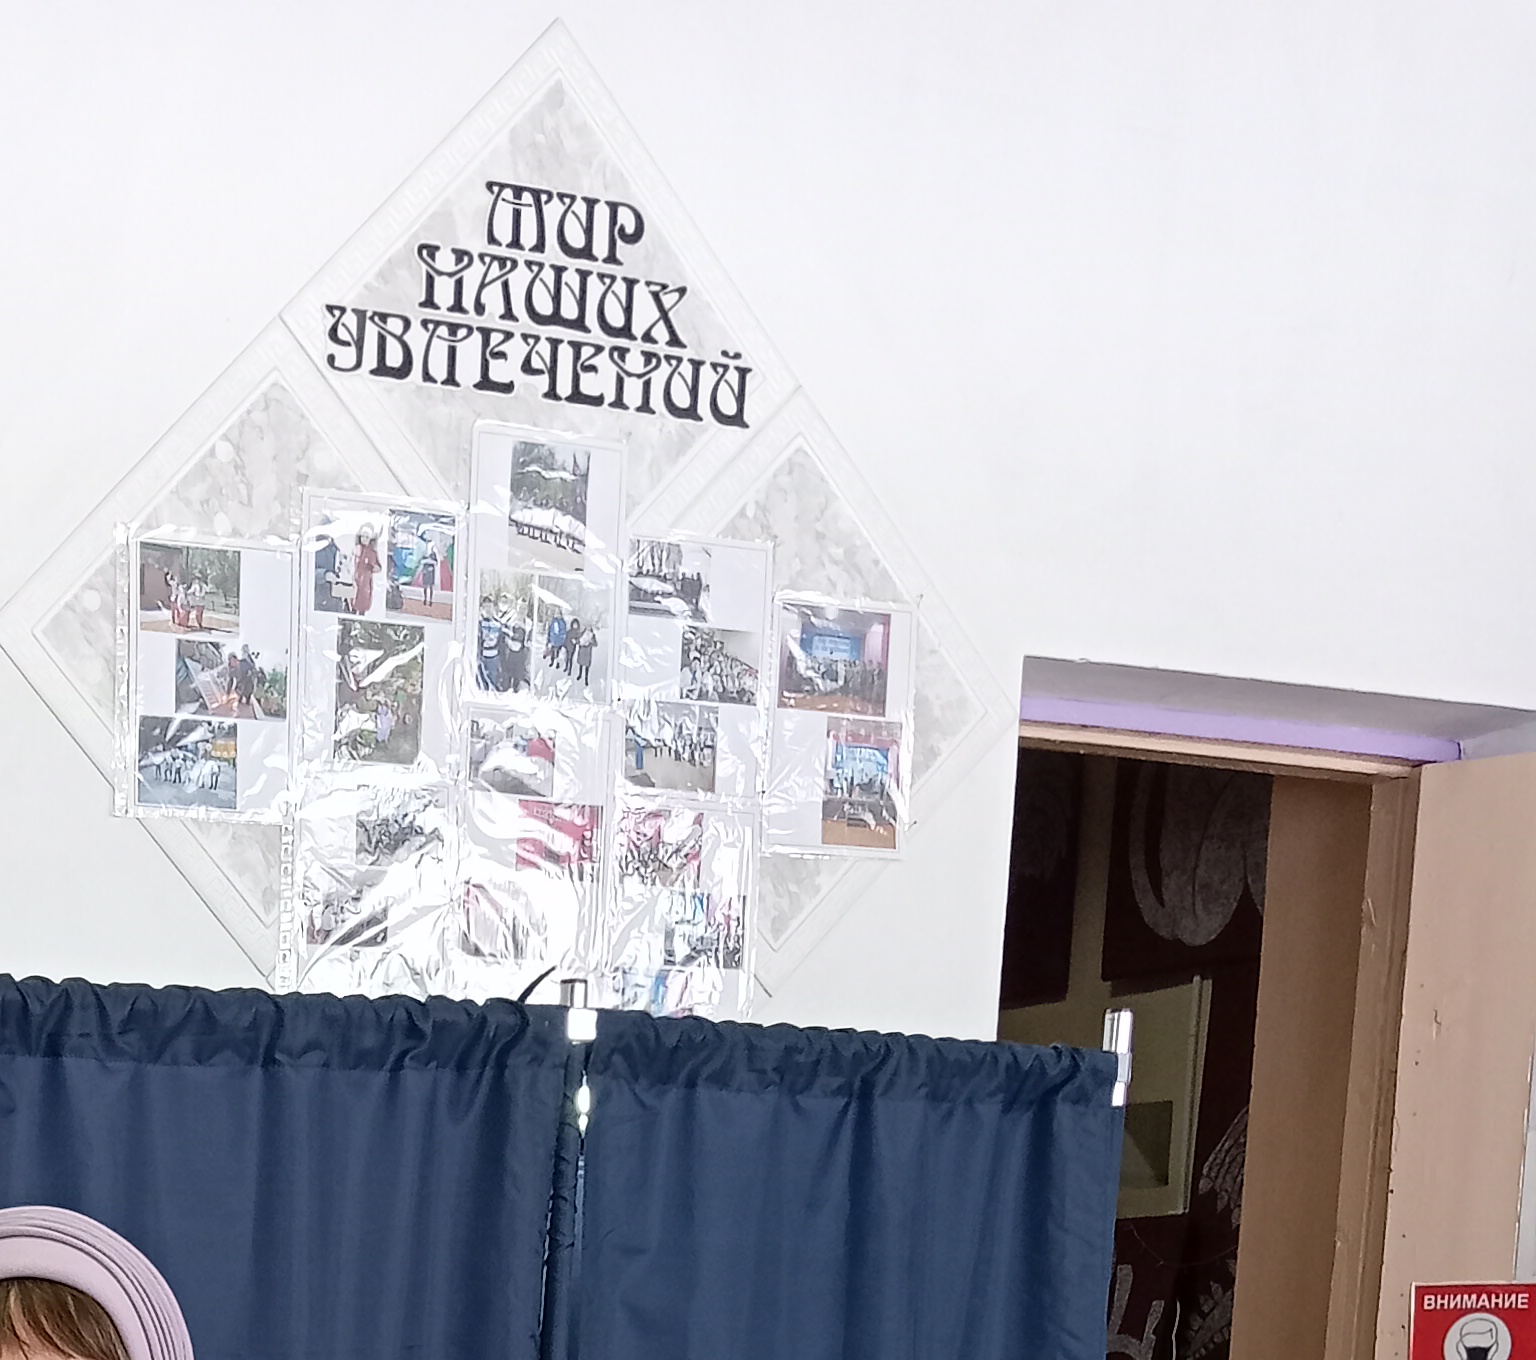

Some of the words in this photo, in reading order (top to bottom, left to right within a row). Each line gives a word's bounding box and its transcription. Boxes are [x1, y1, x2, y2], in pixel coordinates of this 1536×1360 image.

[485, 180, 645, 266] МИР
[416, 243, 688, 349] НАШИХ
[325, 303, 753, 429] УВЛЕЧЕНИЙ
[1423, 1293, 1529, 1310] ВНИМАНИЕ
